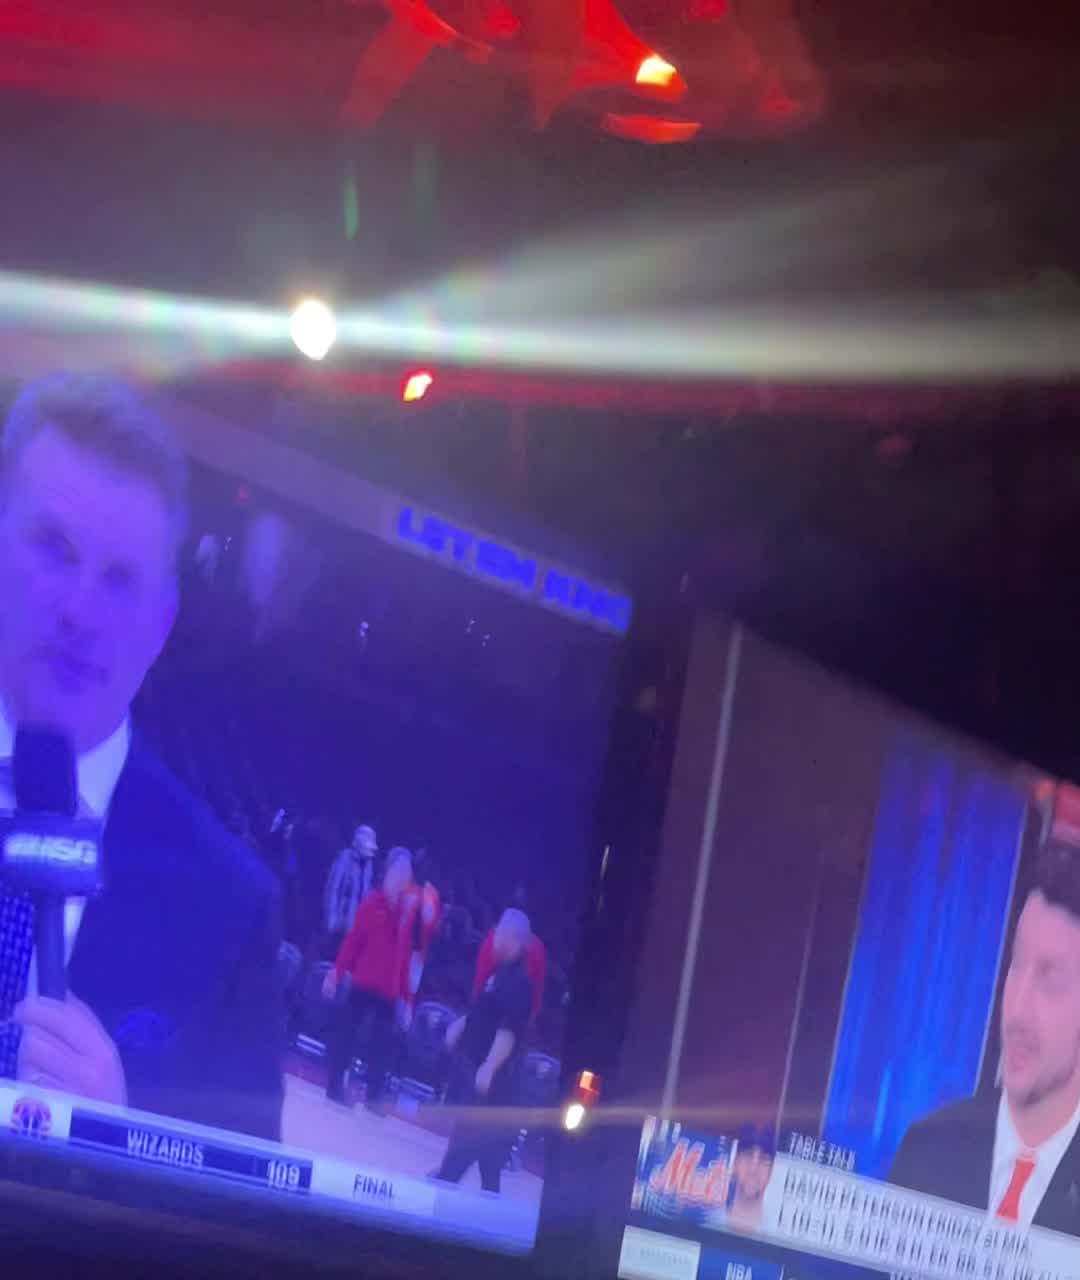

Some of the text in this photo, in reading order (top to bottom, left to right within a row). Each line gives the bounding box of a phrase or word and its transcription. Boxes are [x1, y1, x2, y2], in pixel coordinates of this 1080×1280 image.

[126, 1127, 205, 1166] WIZARDS
[789, 1131, 826, 1163] TABLE
[352, 1173, 397, 1200] FINAL
